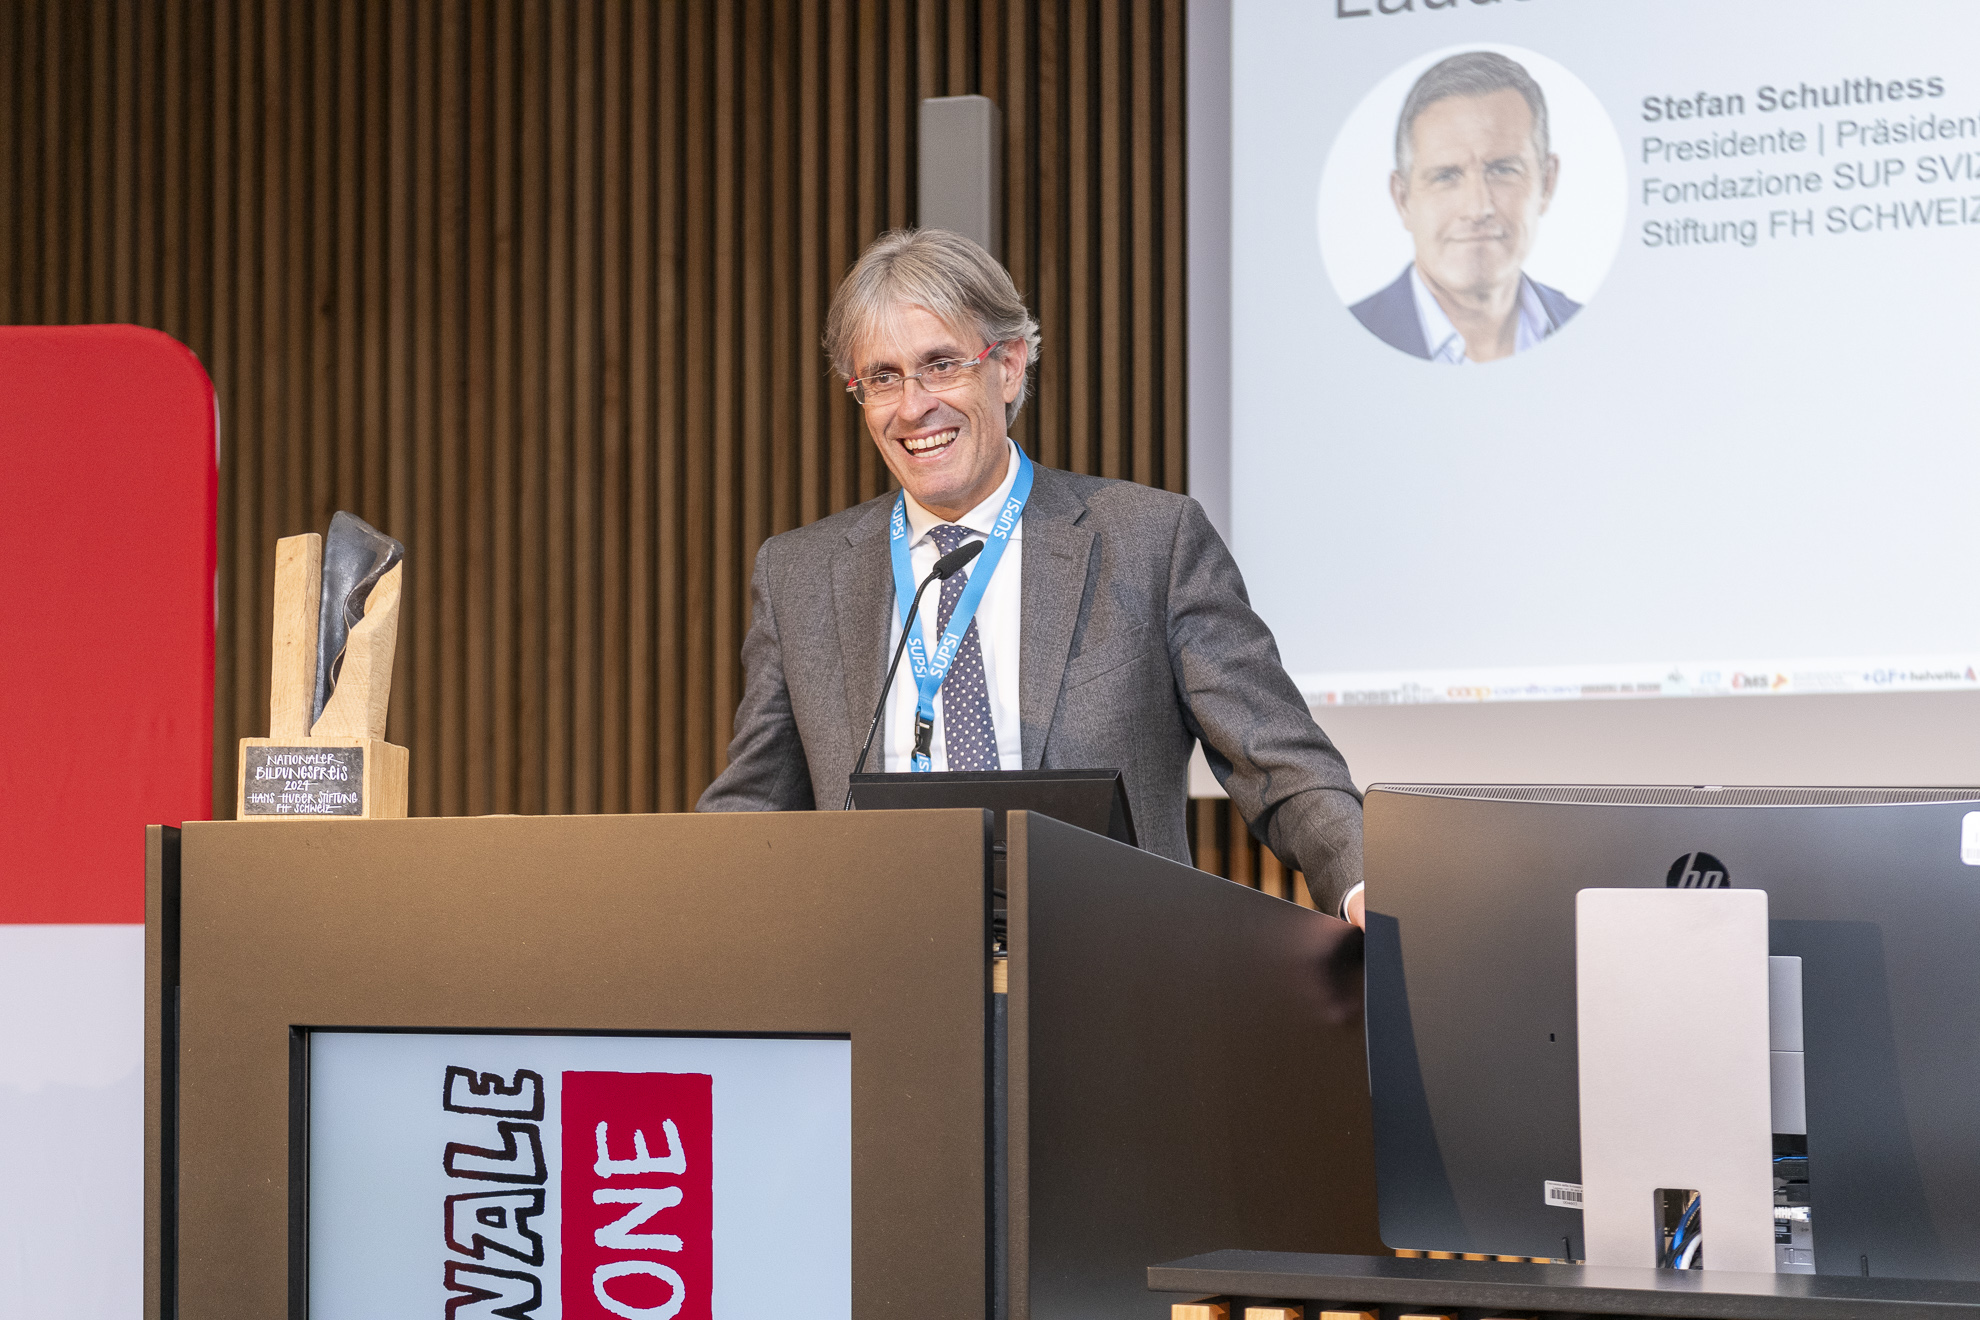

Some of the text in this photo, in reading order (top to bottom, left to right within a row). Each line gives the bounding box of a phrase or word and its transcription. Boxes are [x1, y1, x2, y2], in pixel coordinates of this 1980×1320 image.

[1642, 75, 1945, 122] Stefan Schulthess
[1642, 127, 1807, 164] Presidente
[1837, 113, 1980, 149] Präsiden
[1642, 169, 1822, 206] Fondazione
[1833, 158, 1905, 190] SUP
[1642, 217, 1757, 247] Stiftung
[1769, 208, 1813, 239] FH
[892, 500, 905, 540] SUPSI
[993, 496, 1022, 540] SUPSI
[908, 637, 926, 678] SUPSI
[930, 632, 960, 680] SUPSI
[247, 792, 275, 804] HANS
[283, 780, 318, 791] 2024
[592, 1118, 687, 1320] ONE
